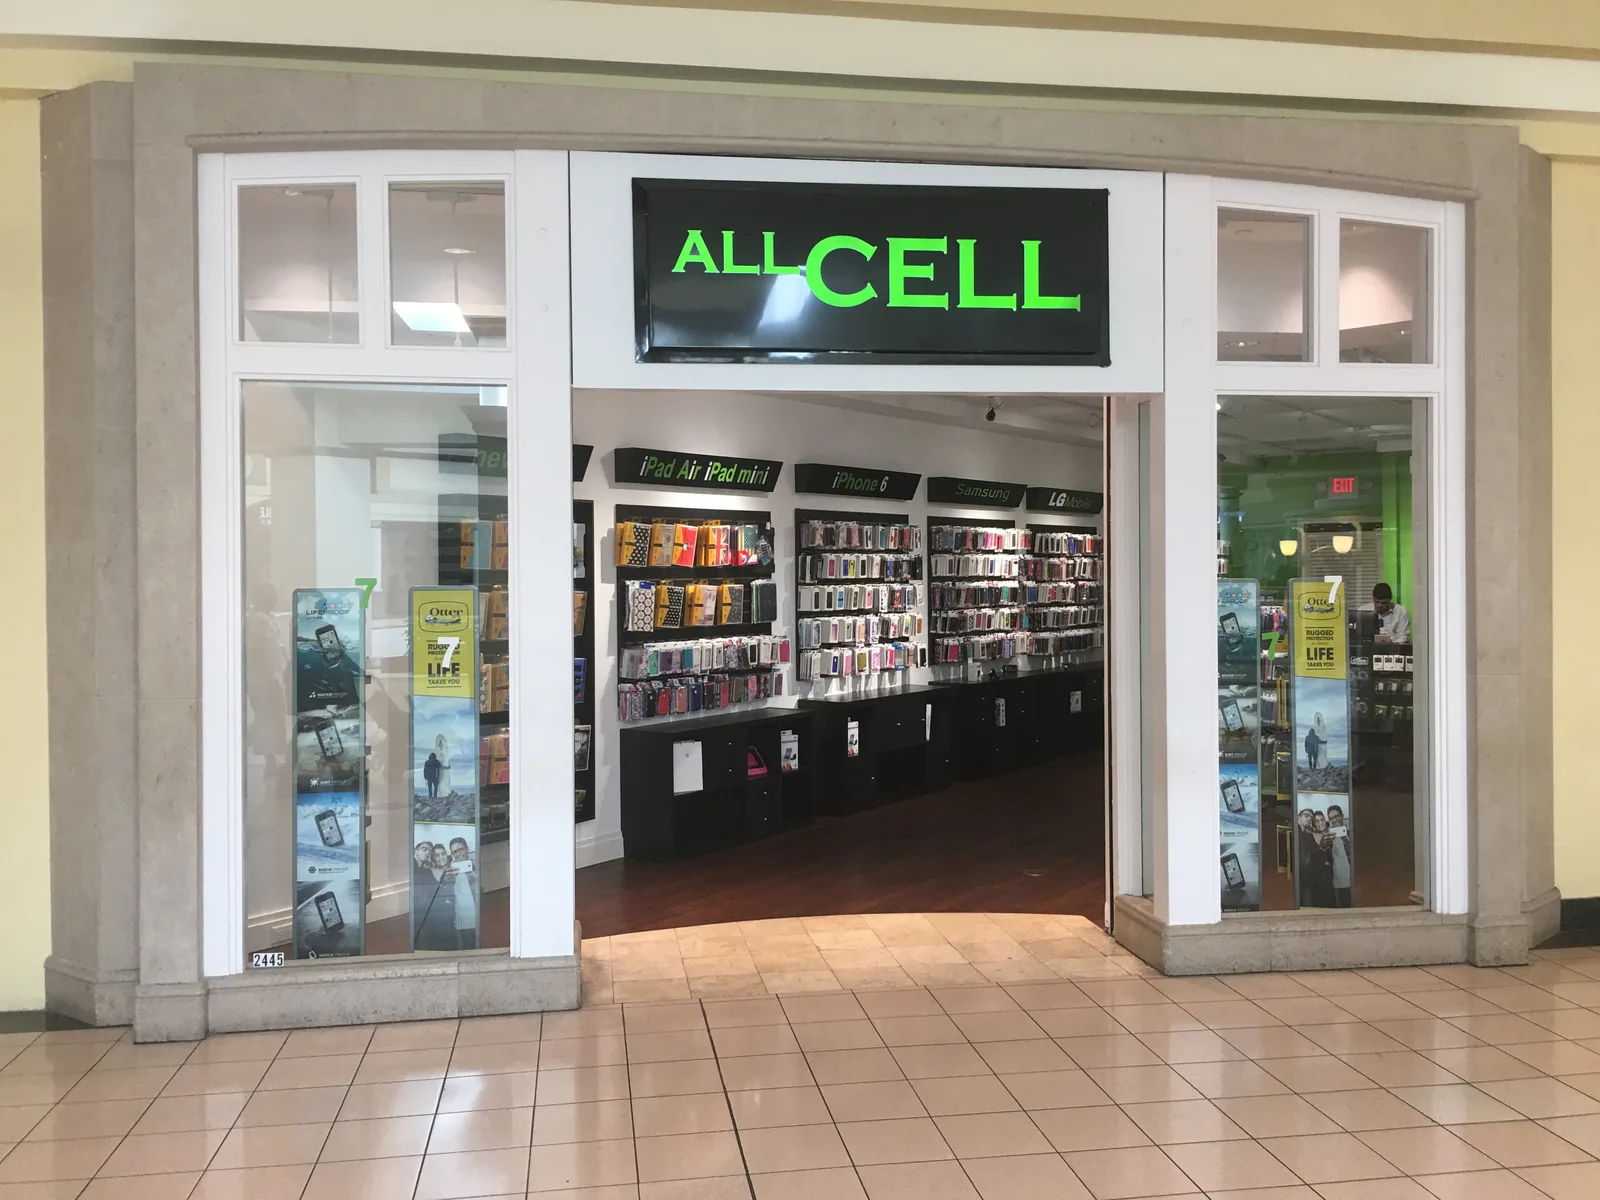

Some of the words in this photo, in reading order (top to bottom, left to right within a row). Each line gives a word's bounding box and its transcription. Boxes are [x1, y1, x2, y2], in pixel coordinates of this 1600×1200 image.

[640, 455, 676, 479] iPad
[676, 459, 702, 480] Air
[704, 461, 738, 483] iPad
[737, 465, 770, 485] mini
[832, 471, 878, 491] iPhone
[880, 475, 889, 492] 6
[1333, 477, 1354, 493] EXIT
[956, 483, 1011, 501] Samsung
[355, 577, 377, 609] 7
[1324, 575, 1342, 604] 7
[429, 607, 463, 616] Otter
[437, 636, 460, 668] 7
[1261, 631, 1279, 661] 7
[1306, 647, 1334, 661] LIFE
[428, 663, 460, 677] LIFE
[254, 953, 283, 967] 2445
